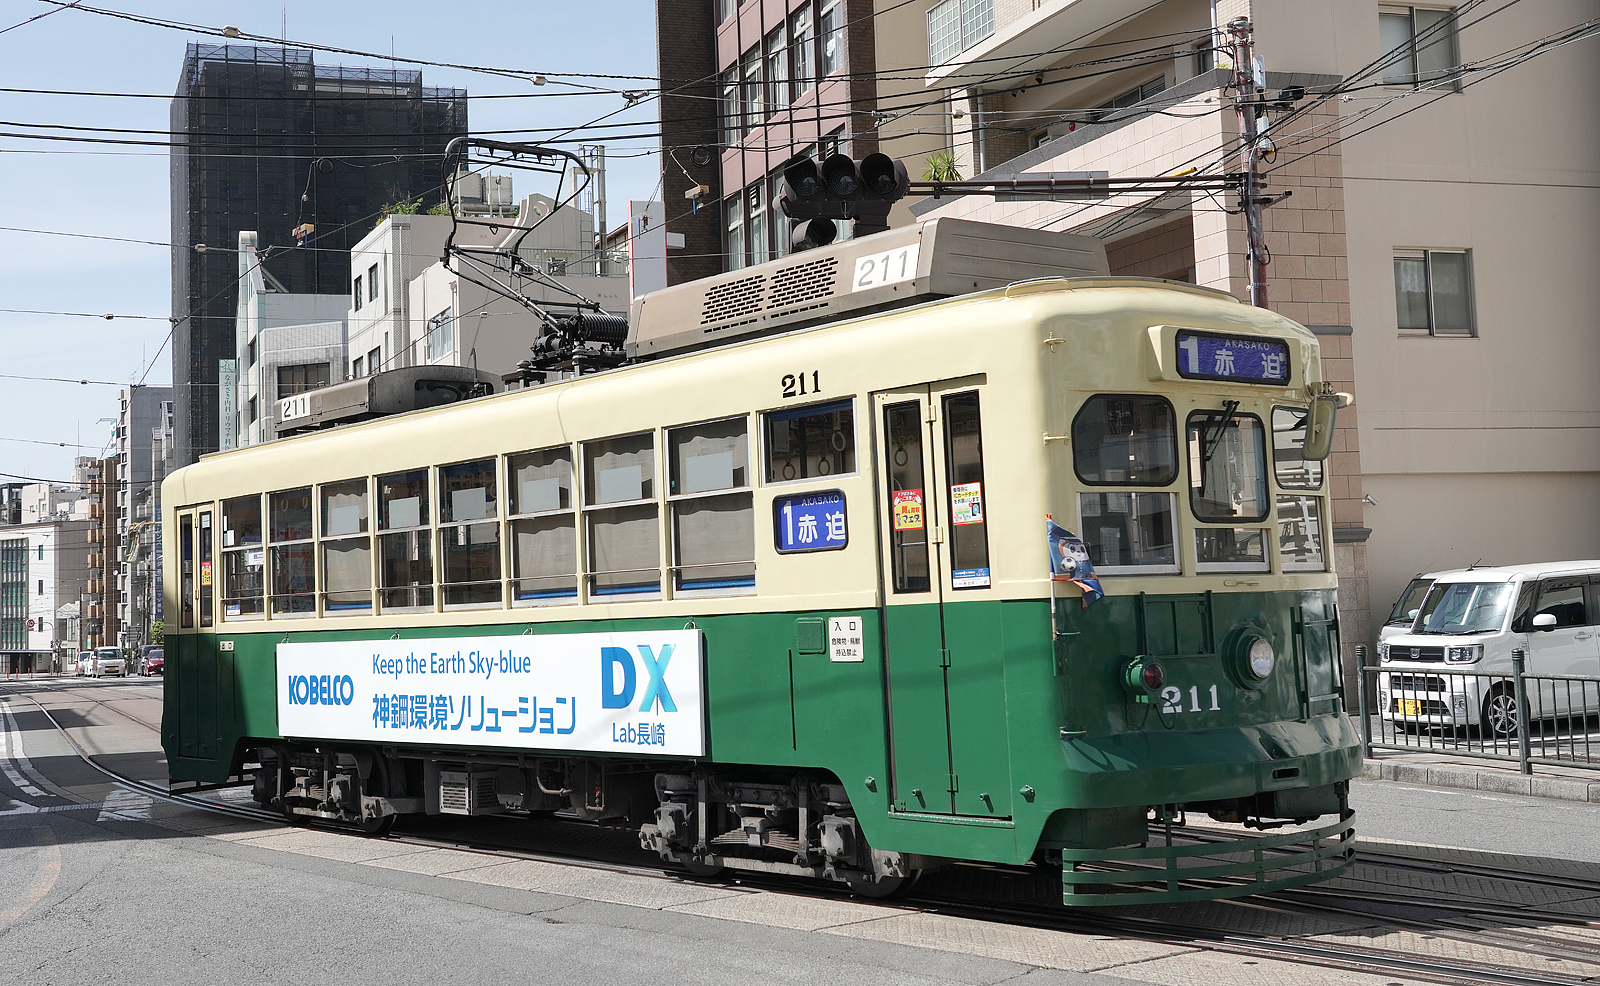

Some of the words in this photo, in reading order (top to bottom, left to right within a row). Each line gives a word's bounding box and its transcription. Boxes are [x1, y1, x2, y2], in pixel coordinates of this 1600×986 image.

[858, 250, 908, 287] 211
[1179, 336, 1200, 374] 1
[1214, 348, 1284, 380] 赤迫
[1225, 340, 1270, 351] AKASAKO
[781, 370, 822, 398] 211
[283, 397, 305, 418] 211
[801, 495, 839, 507] AKASAKO
[783, 500, 794, 545] 1
[798, 510, 846, 544] 赤迫
[834, 621, 857, 632] 入口
[372, 653, 403, 680] Keep
[406, 652, 427, 674] the
[430, 651, 465, 674] Earth
[469, 649, 531, 680] Sky-blue
[600, 643, 678, 712] DX
[288, 674, 354, 706] KOBELCO
[1160, 684, 1221, 714] 211
[372, 693, 576, 735] 神鋼環境ソリューション
[612, 722, 665, 747] Lab長崎
